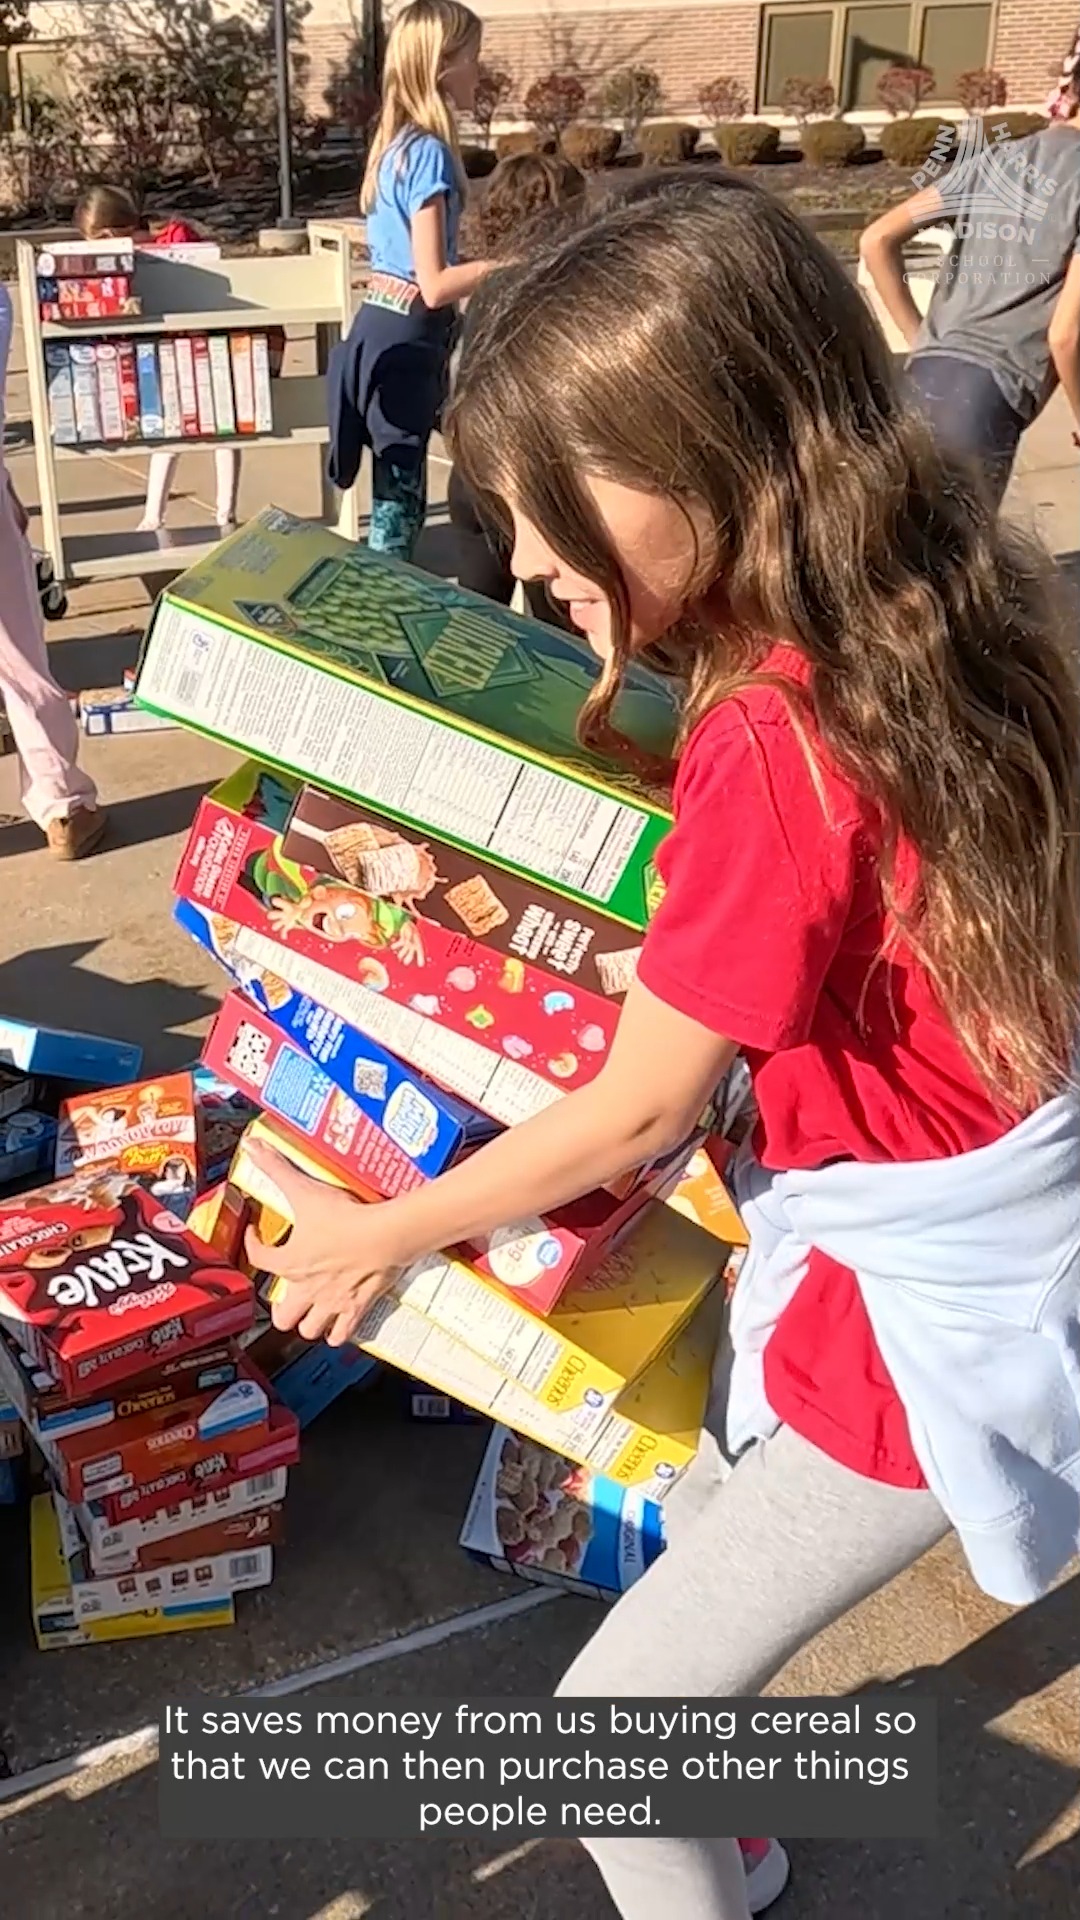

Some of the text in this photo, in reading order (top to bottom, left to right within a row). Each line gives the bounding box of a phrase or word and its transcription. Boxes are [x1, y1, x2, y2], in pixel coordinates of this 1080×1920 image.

[424, 607, 529, 691] WICKED
[546, 1354, 588, 1408] Cheerios
[616, 1433, 659, 1481] Cheerios
